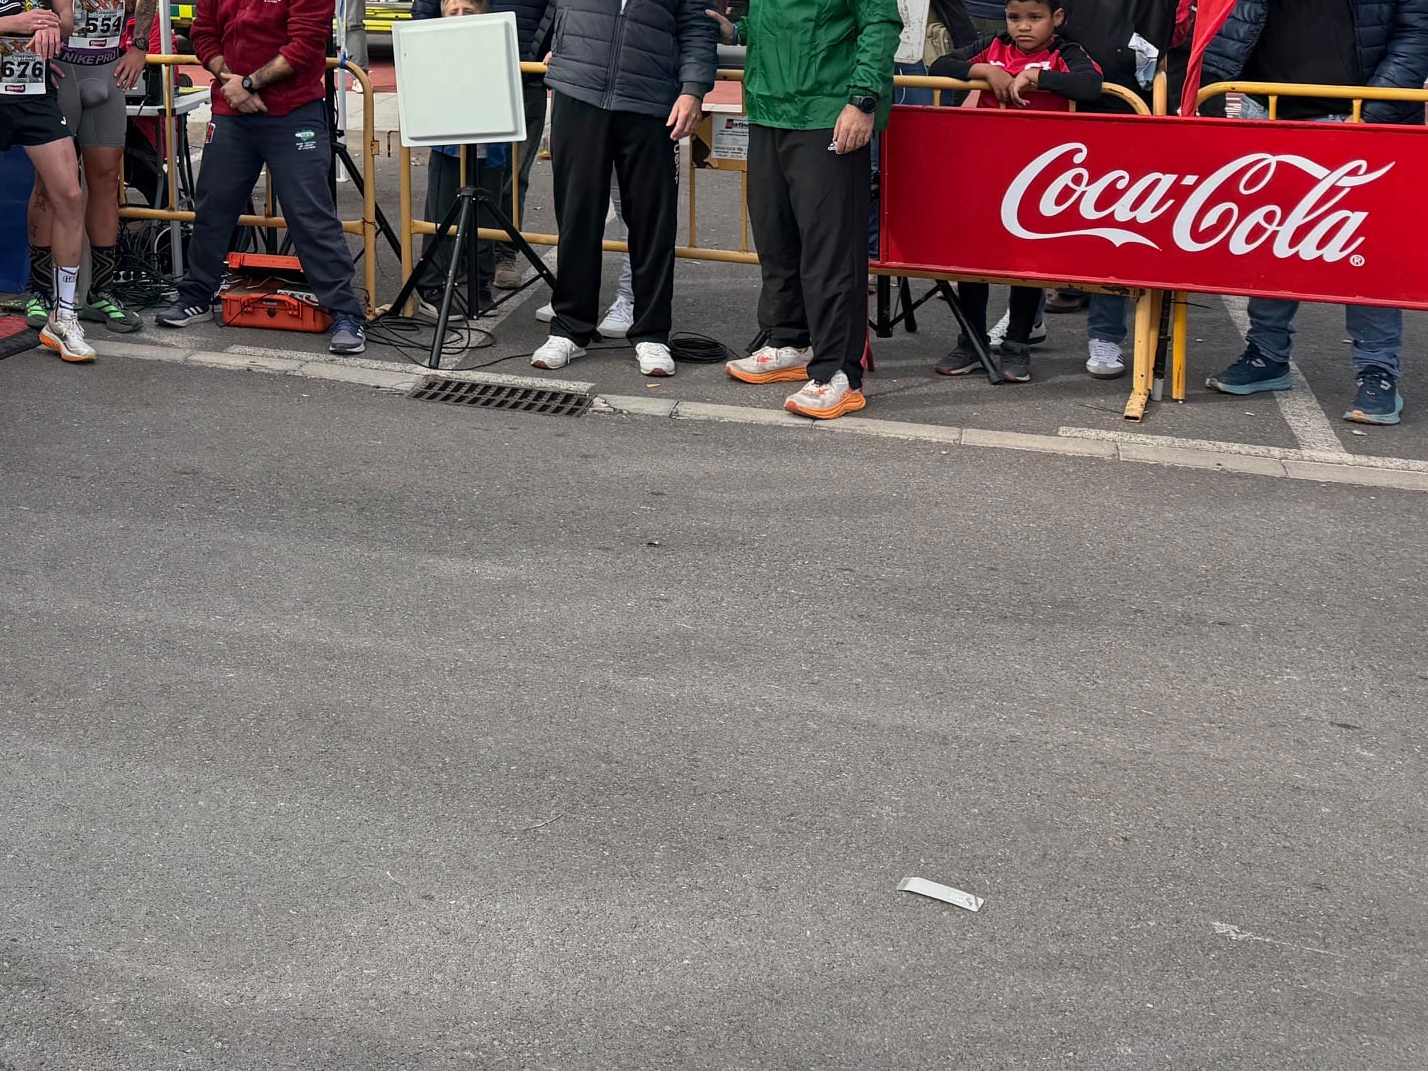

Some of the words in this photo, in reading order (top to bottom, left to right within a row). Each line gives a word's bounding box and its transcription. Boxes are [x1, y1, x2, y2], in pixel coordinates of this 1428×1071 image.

[86, 15, 122, 34] 554
[62, 51, 95, 65] NIKE
[1, 60, 44, 79] 676
[1000, 142, 1396, 264] Coca-Cola
